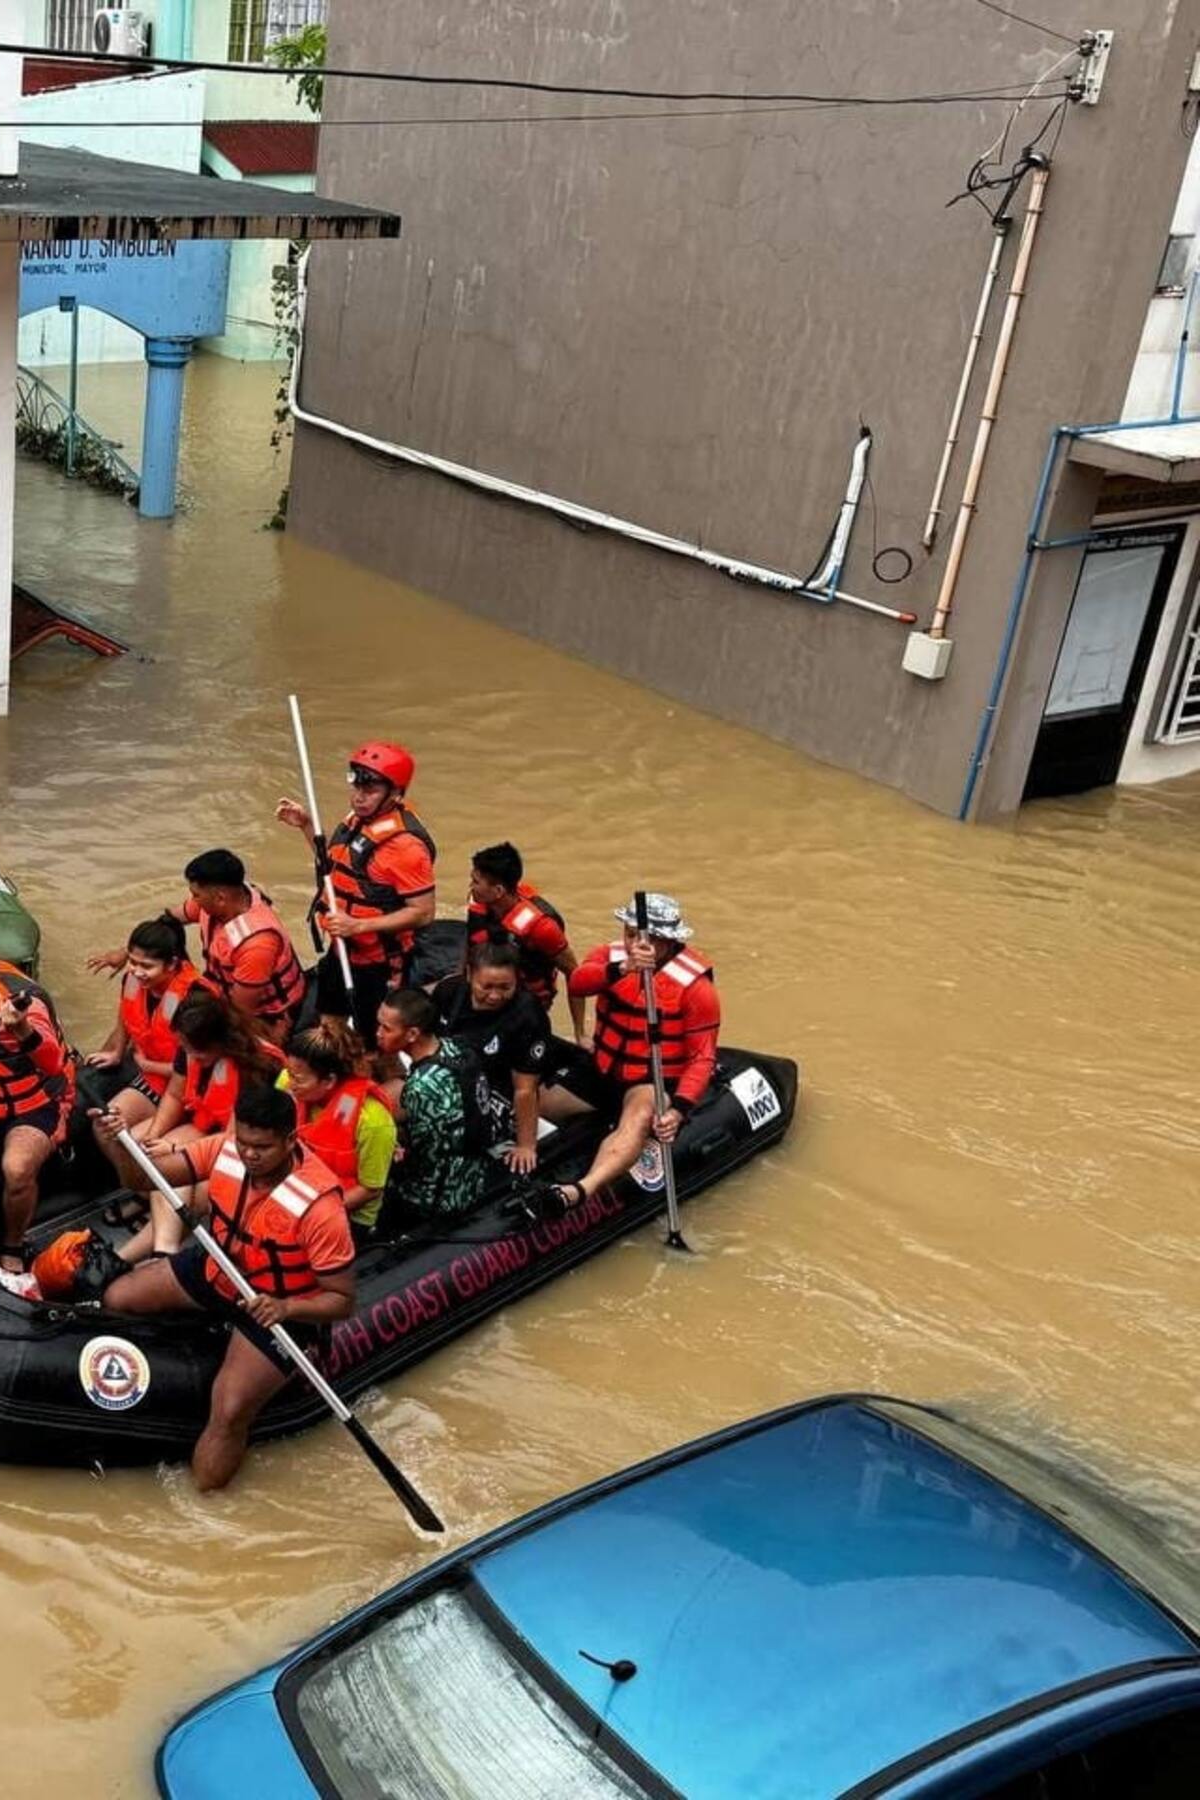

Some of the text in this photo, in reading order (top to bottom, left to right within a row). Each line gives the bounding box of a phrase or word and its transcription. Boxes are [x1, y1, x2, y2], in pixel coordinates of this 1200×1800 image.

[22, 262, 108, 276] MUNICIPAL MAYOR
[371, 1270, 450, 1343] COAST
[450, 1233, 530, 1298] GUARD
